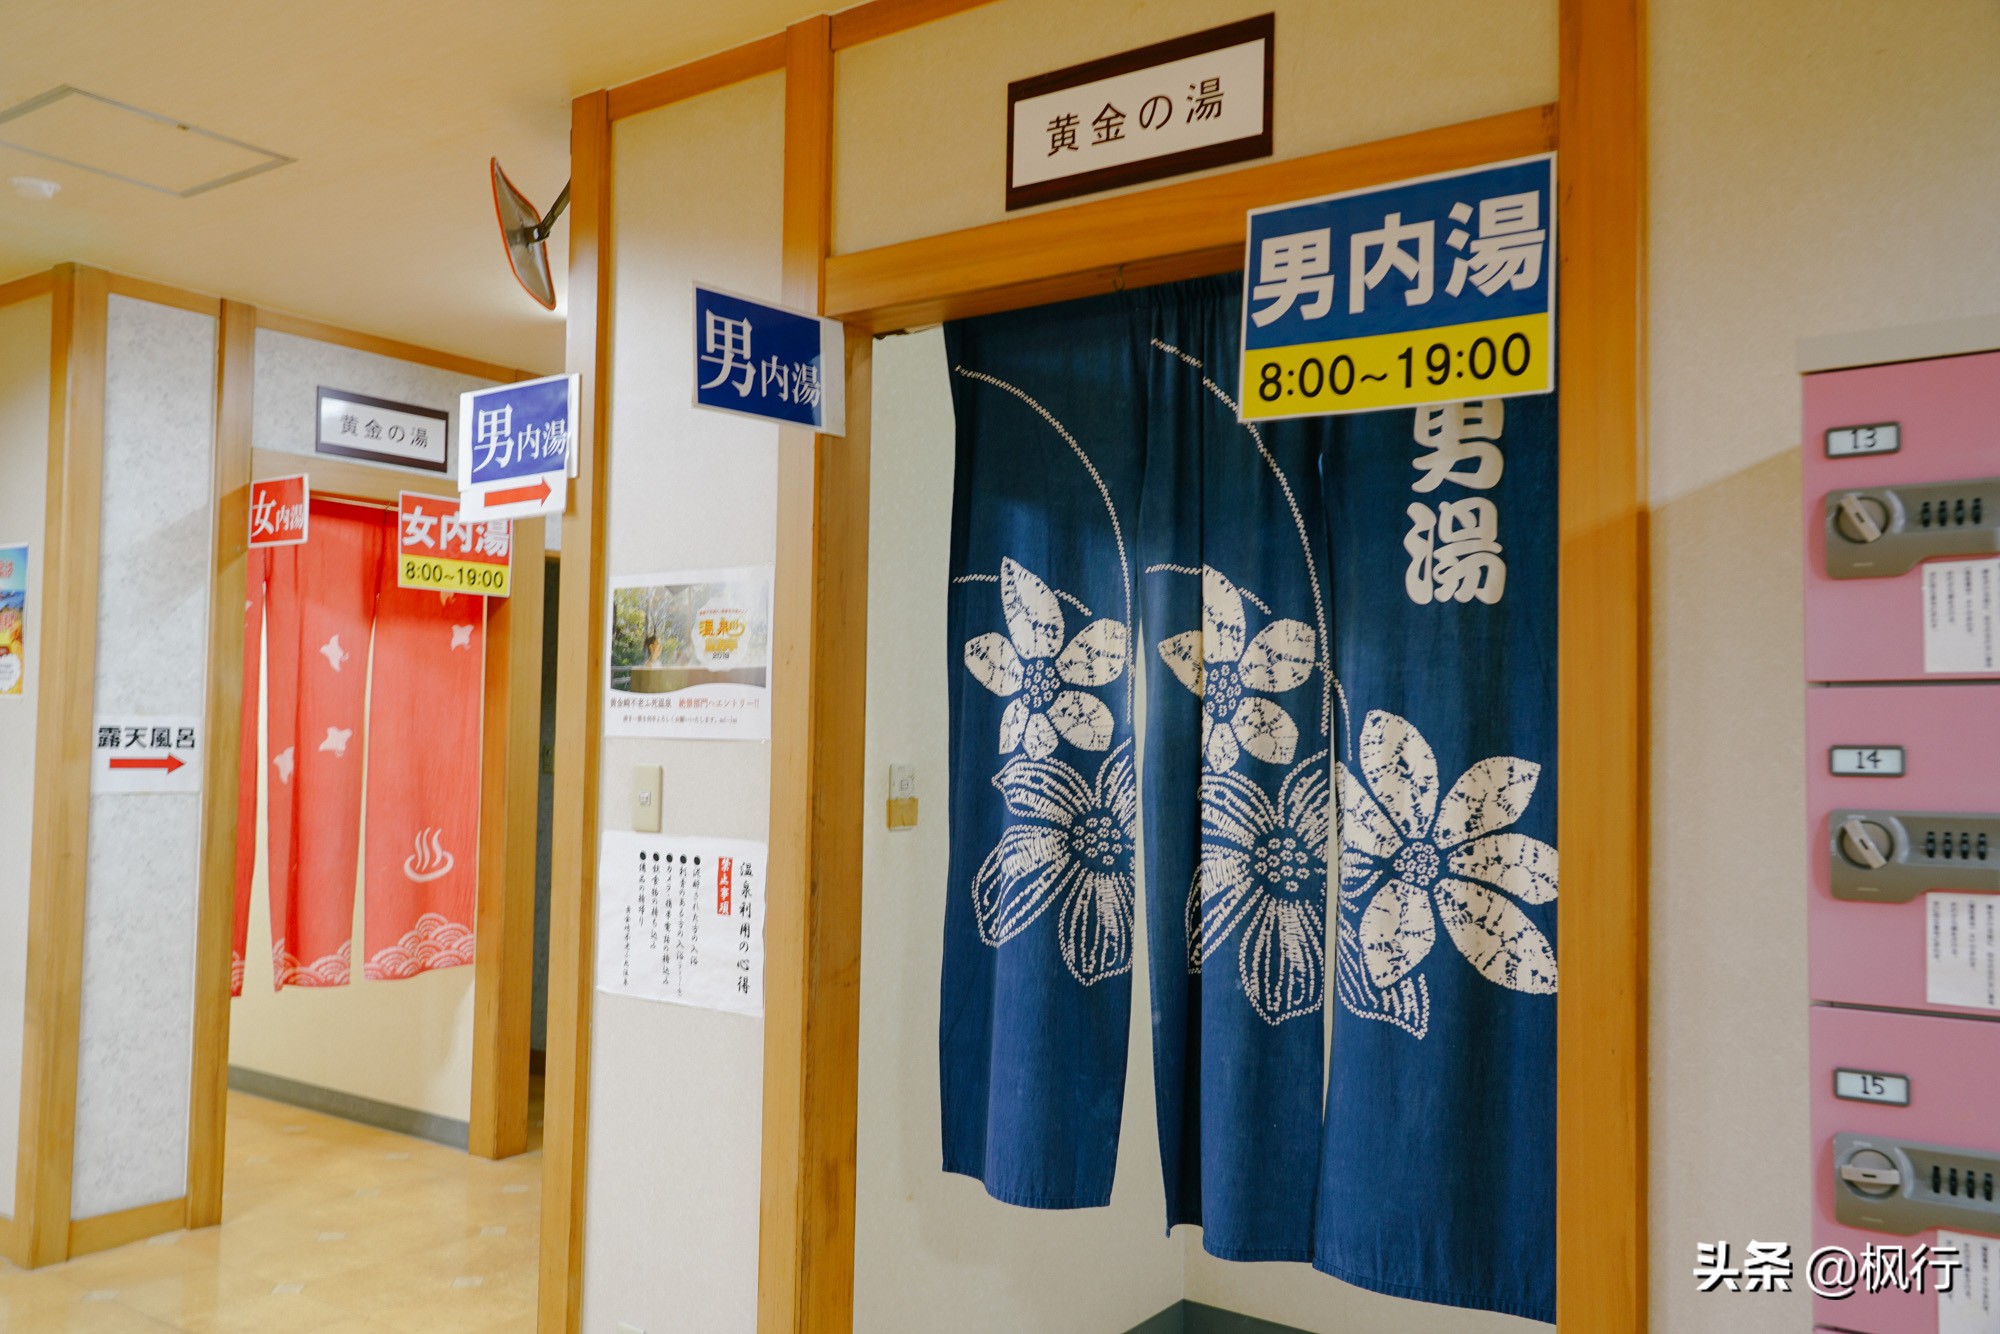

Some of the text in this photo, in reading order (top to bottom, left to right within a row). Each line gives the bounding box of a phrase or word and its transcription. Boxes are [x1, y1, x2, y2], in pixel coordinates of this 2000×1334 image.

[1046, 75, 1225, 157] 黄金の湯
[1251, 189, 1547, 329] 男内湯
[701, 308, 822, 408] 男内湯
[339, 413, 429, 448] 黄金の湯
[473, 402, 570, 473] 男内湯
[1850, 428, 1877, 449] 13
[251, 489, 304, 538] 女内湯
[1401, 399, 1506, 605] 男湯
[401, 504, 511, 558] 女内湯
[97, 725, 196, 750] 露天風呂
[1856, 750, 1882, 770] 14
[736, 861, 754, 995] 温泉利用の心得
[1860, 1075, 1886, 1096] 15
